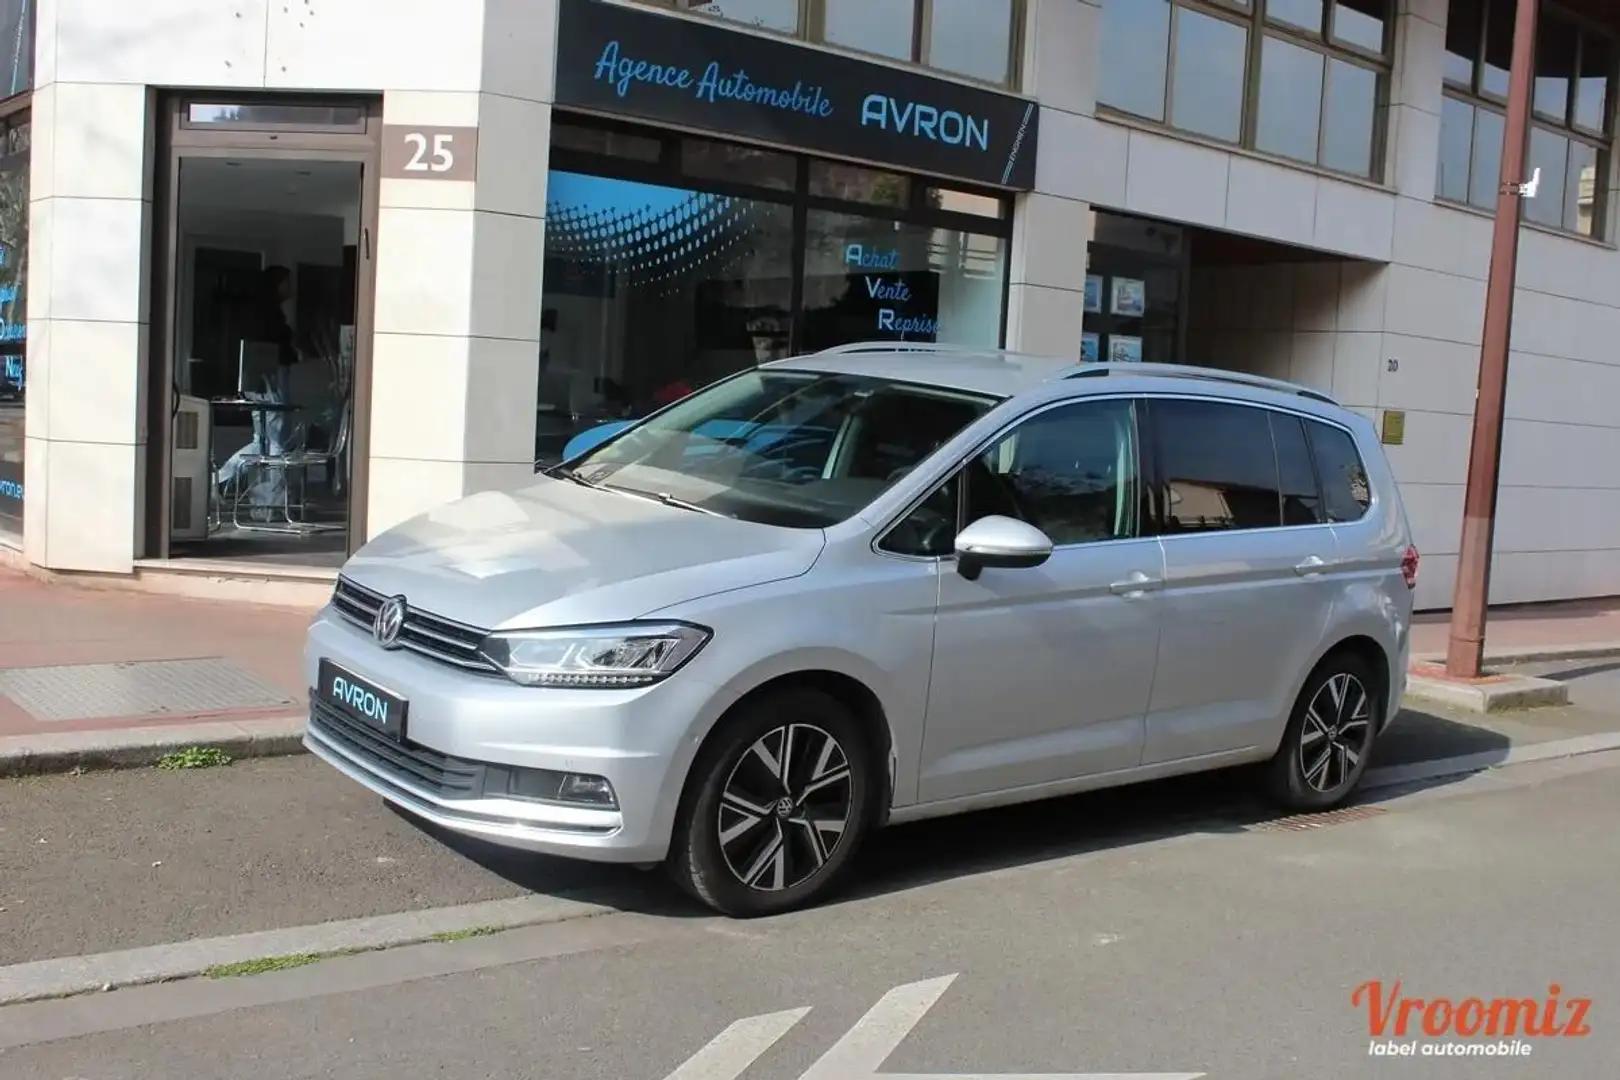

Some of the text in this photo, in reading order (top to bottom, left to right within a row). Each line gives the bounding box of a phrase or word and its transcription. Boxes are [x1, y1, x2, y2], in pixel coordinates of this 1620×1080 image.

[594, 41, 835, 119] Agence Automobile
[861, 94, 990, 151] AVRON
[403, 132, 455, 173] 25
[845, 243, 897, 269] Achat
[864, 276, 913, 301] Vente
[878, 308, 940, 342] Reprise
[1388, 358, 1399, 372] 20
[332, 676, 388, 725] AVRON
